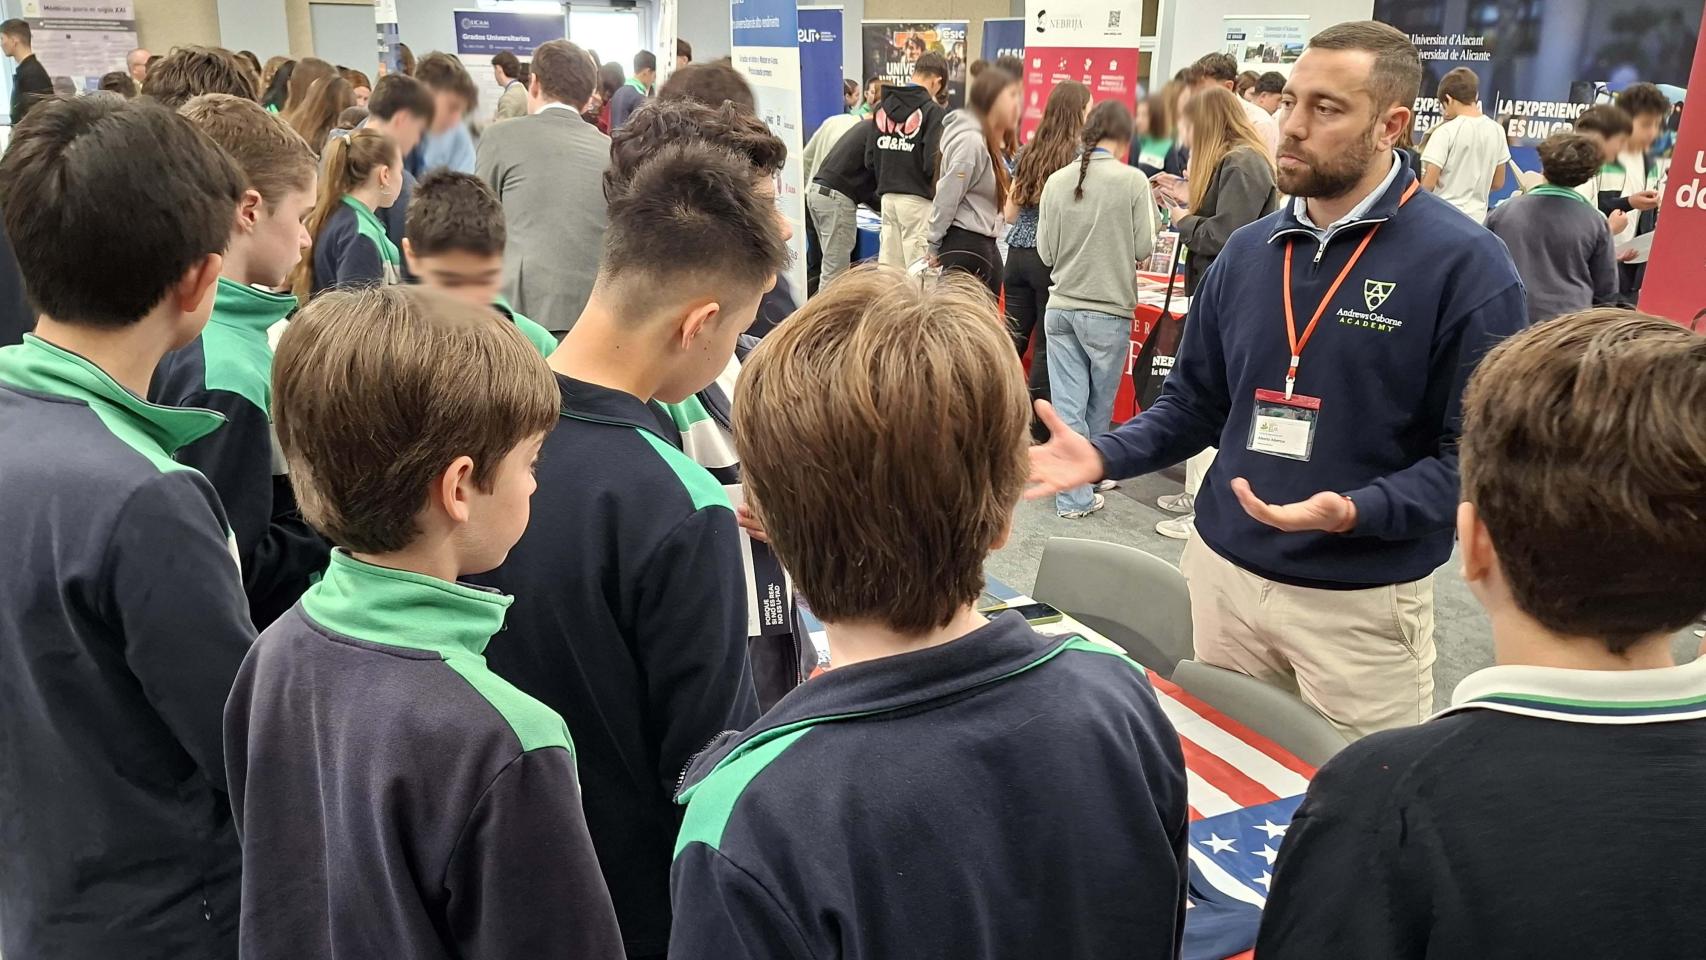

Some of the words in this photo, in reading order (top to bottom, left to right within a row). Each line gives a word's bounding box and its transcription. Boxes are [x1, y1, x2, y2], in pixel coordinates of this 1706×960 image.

[462, 33, 485, 41] Grados
[486, 34, 530, 42] Universitarios
[1411, 33, 1448, 46] Universitat
[1449, 33, 1484, 47] d'Alacant
[1418, 49, 1449, 60] iversidad
[1449, 49, 1459, 60] de
[1460, 49, 1491, 61] Alicante
[886, 62, 916, 75] UNIVE
[1498, 99, 1514, 115] LA
[1507, 119, 1527, 137] ES
[1527, 120, 1550, 139] UN
[1336, 308, 1370, 320] Andrews
[1369, 312, 1403, 327] Osborne
[1339, 317, 1395, 332] ACADEMY
[1151, 355, 1176, 367] NEB
[771, 608, 776, 618] NO
[778, 614, 783, 624] NO
